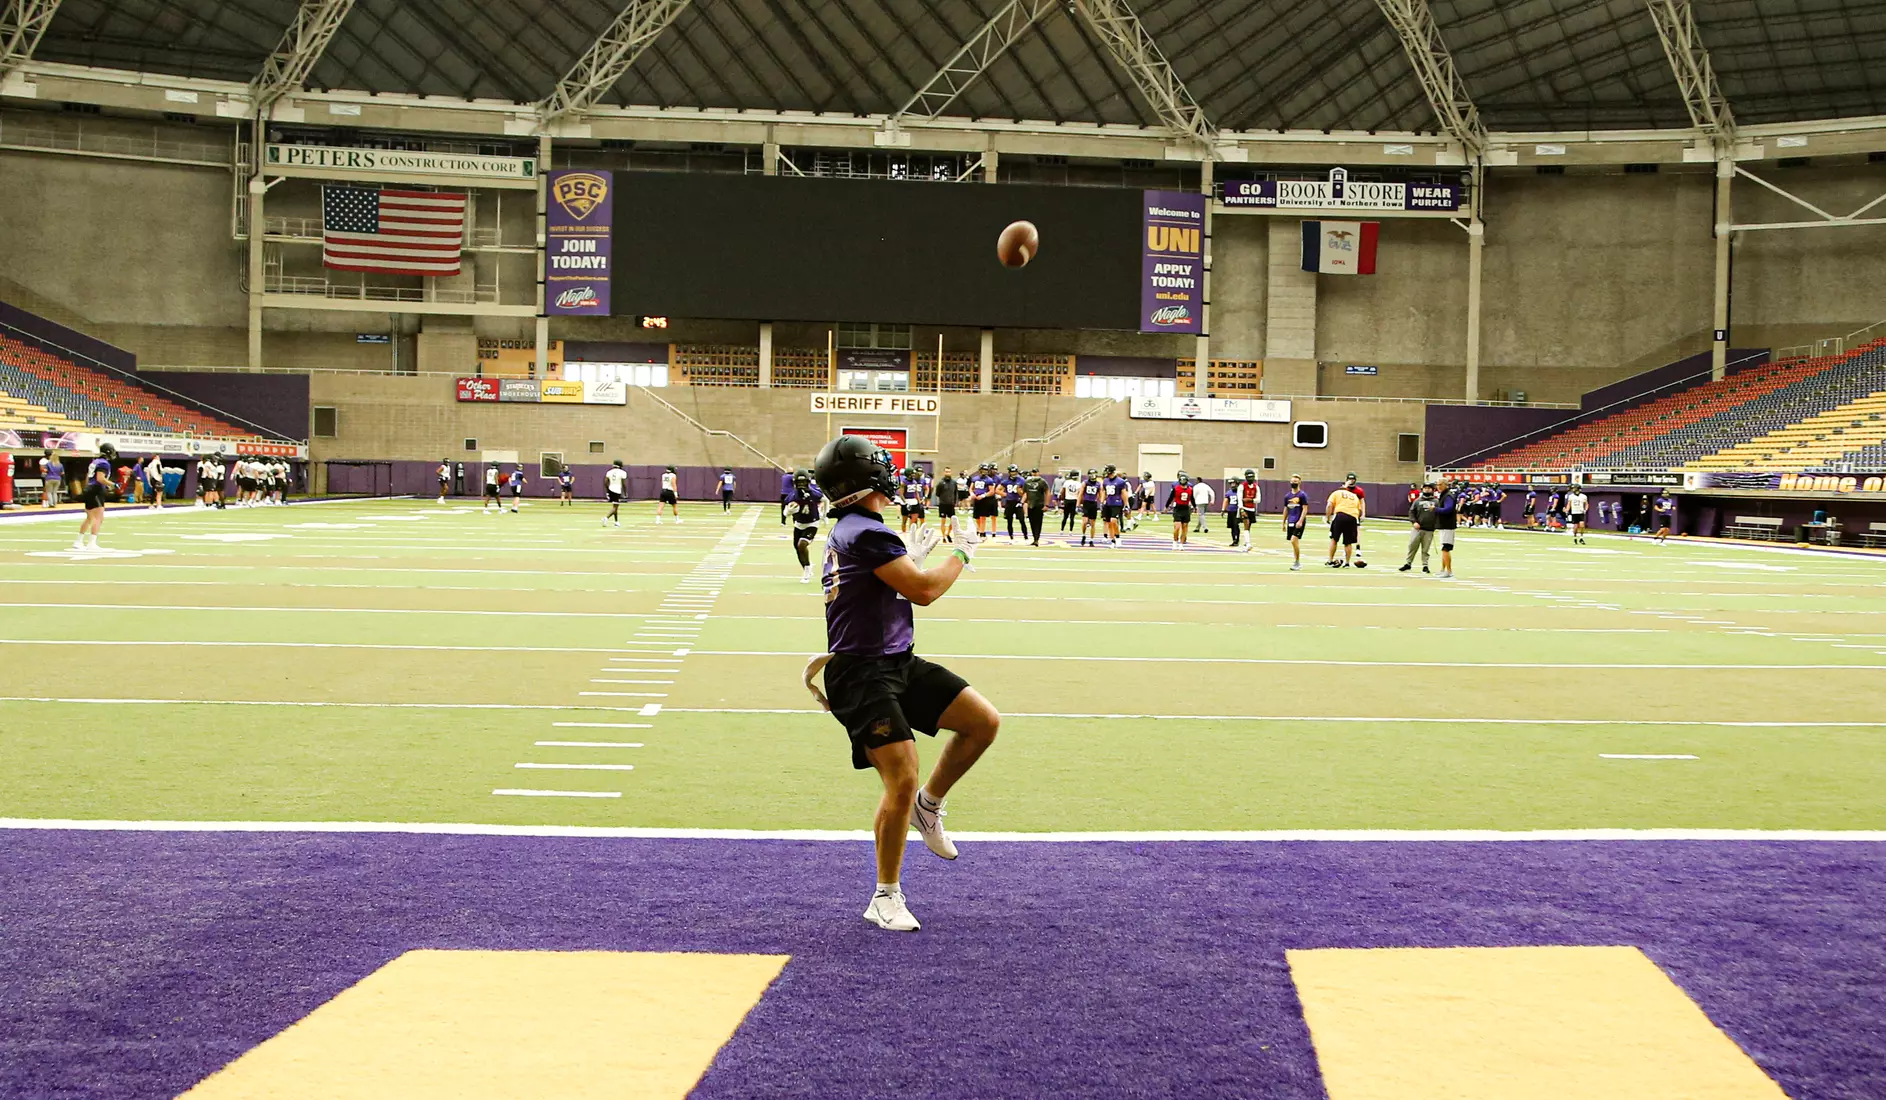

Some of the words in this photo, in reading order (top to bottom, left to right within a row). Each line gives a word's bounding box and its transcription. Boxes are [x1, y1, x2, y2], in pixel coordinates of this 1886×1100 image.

[287, 148, 375, 168] PETERS
[380, 156, 479, 171] CONSTRUCTION
[482, 161, 516, 173] CORP.
[560, 181, 601, 199] PSC
[1239, 184, 1262, 195] GO
[1280, 182, 1327, 199] BOOK
[1348, 184, 1404, 200] STORE
[1412, 187, 1452, 198] WEAR
[1225, 196, 1276, 205] PANTHERS!
[1280, 199, 1323, 207] University
[1411, 199, 1452, 207] PURPLE!
[1148, 206, 1190, 218] Welcome
[1191, 211, 1200, 219] to
[1147, 225, 1200, 253] UNI
[561, 239, 596, 252] JOIN
[551, 256, 607, 269] TODAY!
[1154, 263, 1192, 275] APPLY
[1150, 276, 1195, 289] TODAY!
[555, 286, 593, 307] Nagle
[1155, 292, 1189, 300] uni.edu
[1151, 305, 1187, 323] Nagle
[643, 316, 667, 328] 2:45
[1716, 331, 1723, 340] U
[466, 380, 491, 391] Other
[543, 386, 582, 396] SUBWAY
[473, 390, 496, 400] Place
[815, 396, 883, 410] SHERIFF
[891, 398, 937, 411] FIELD
[1006, 484, 1018, 493] 84
[1779, 474, 1857, 492] Home
[1086, 485, 1097, 495] 83
[1180, 492, 1188, 501] 2
[801, 504, 810, 514] 4
